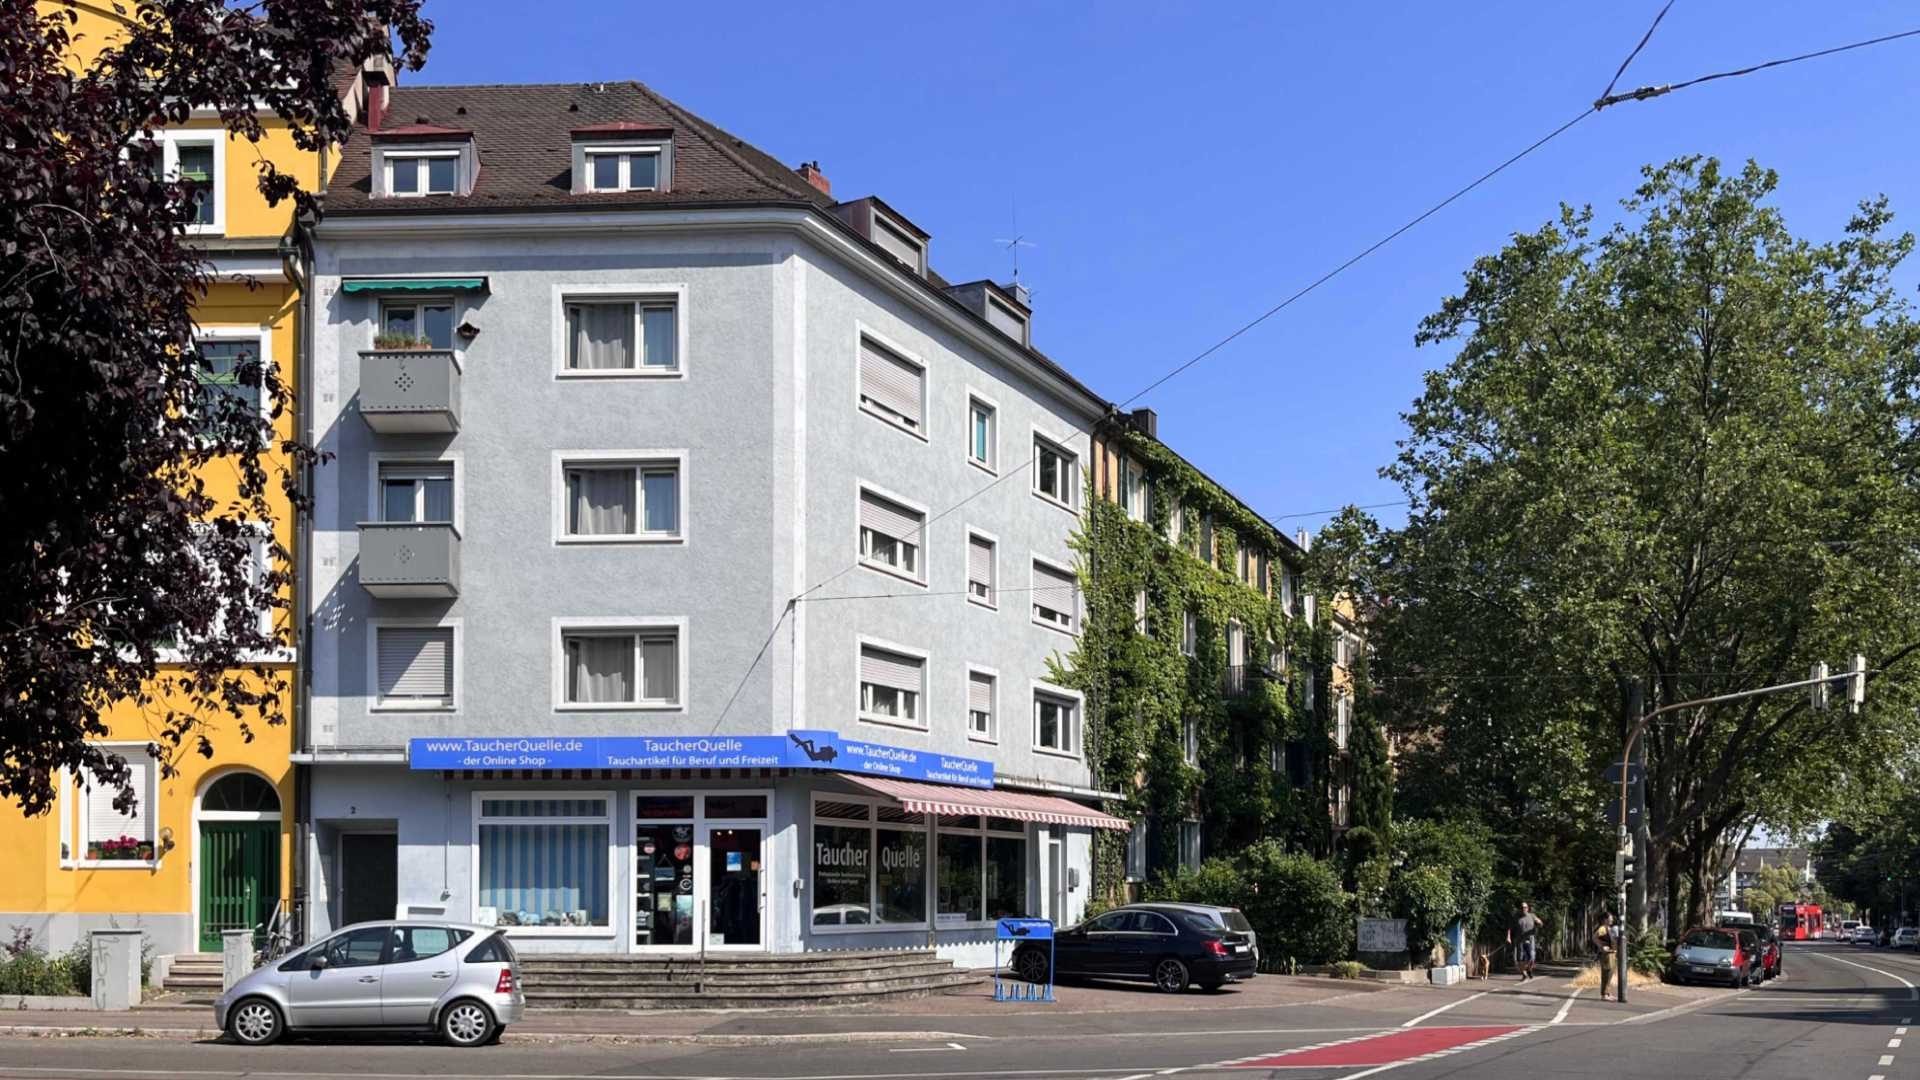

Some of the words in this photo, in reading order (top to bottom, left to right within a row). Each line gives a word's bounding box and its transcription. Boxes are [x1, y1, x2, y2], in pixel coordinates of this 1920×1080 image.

[426, 739, 584, 753] www.TaucherQuelle.de
[643, 738, 743, 753] TaucherQuelle
[607, 755, 669, 766] Tauchartikel
[672, 755, 686, 765] für
[689, 755, 716, 765] Beruf
[720, 755, 739, 765] und
[742, 755, 779, 766] Freizeit
[846, 744, 917, 763] www.TaucherQuelle.de
[463, 756, 481, 765] der
[483, 756, 516, 766] Online
[519, 756, 546, 767] Shop
[940, 757, 978, 773] TaucherQuelle
[815, 842, 869, 867] Taucher
[882, 845, 921, 872] Quelle
